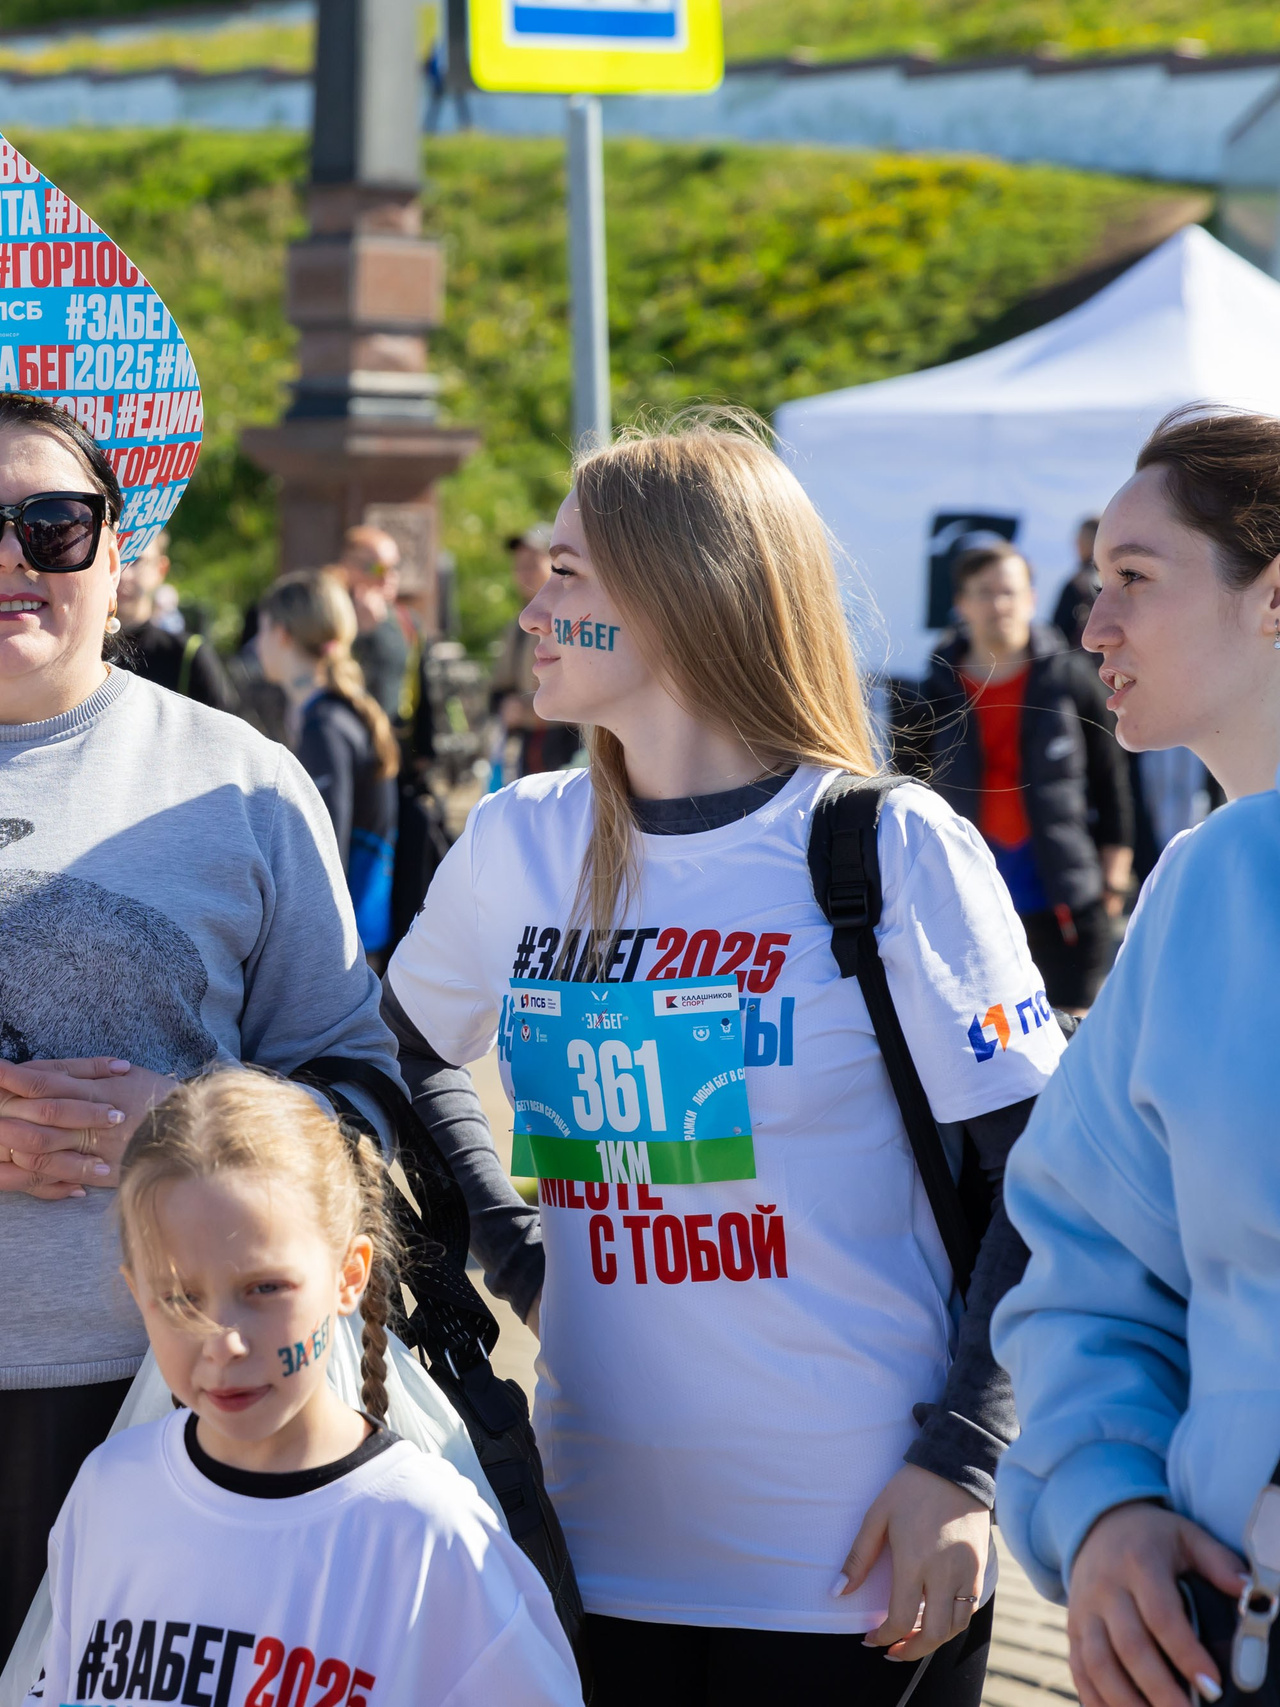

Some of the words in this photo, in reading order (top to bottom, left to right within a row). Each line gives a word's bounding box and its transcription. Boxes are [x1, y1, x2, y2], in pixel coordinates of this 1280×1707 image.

[66, 294, 185, 340] #ЗАБЕГ
[530, 996, 546, 1008] ПСБ
[681, 993, 732, 1001] КАЛАШНИКОВ
[566, 1039, 667, 1132] 361
[692, 1080, 717, 1106] ЛЮБИ
[713, 1072, 729, 1088] БЕГ
[729, 1070, 737, 1082] В
[736, 1068, 745, 1080] С
[683, 1109, 697, 1141] РАМКИ
[589, 1214, 617, 1284] С
[623, 1204, 788, 1284] ТОБОЙ
